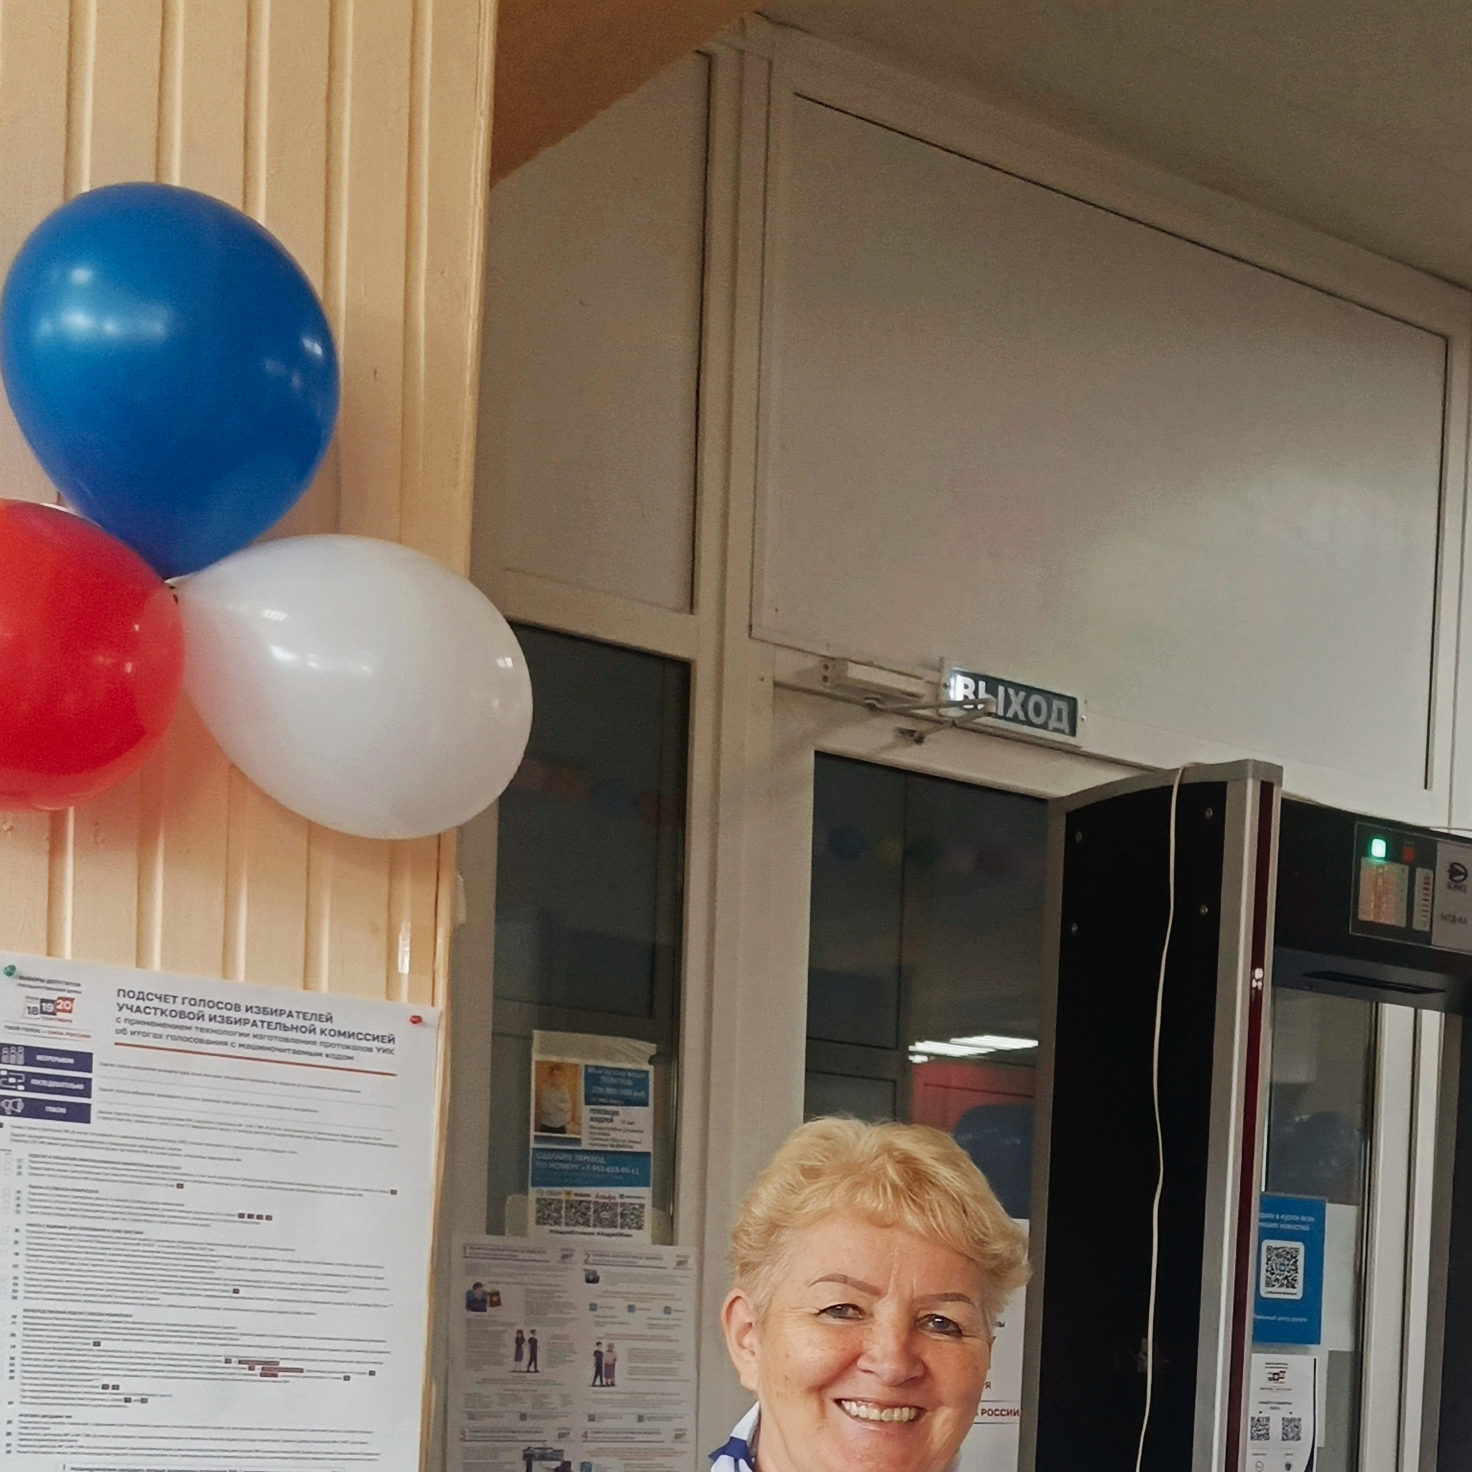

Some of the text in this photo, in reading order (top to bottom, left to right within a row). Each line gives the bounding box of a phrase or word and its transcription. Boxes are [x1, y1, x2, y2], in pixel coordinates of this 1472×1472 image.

[955, 673, 1071, 735] ВЫХОД
[26, 1000, 72, 1015] 18 19 20
[117, 988, 334, 1024] ПОДСЧЕТ ГОЛОСОВ ИЗБИРАТЕЛЕЙ
[117, 1002, 396, 1045] УЧАСТКОВОЙ ИЗБИРАТЕЛЬНОЙ КОМИССИЕЙ
[115, 1027, 128, 1036] об
[130, 1030, 163, 1039] итогах
[165, 1034, 228, 1047] голосования
[325, 1053, 354, 1061] кодом
[376, 1046, 395, 1055] УИК
[981, 1408, 1020, 1417] РОССИИ
